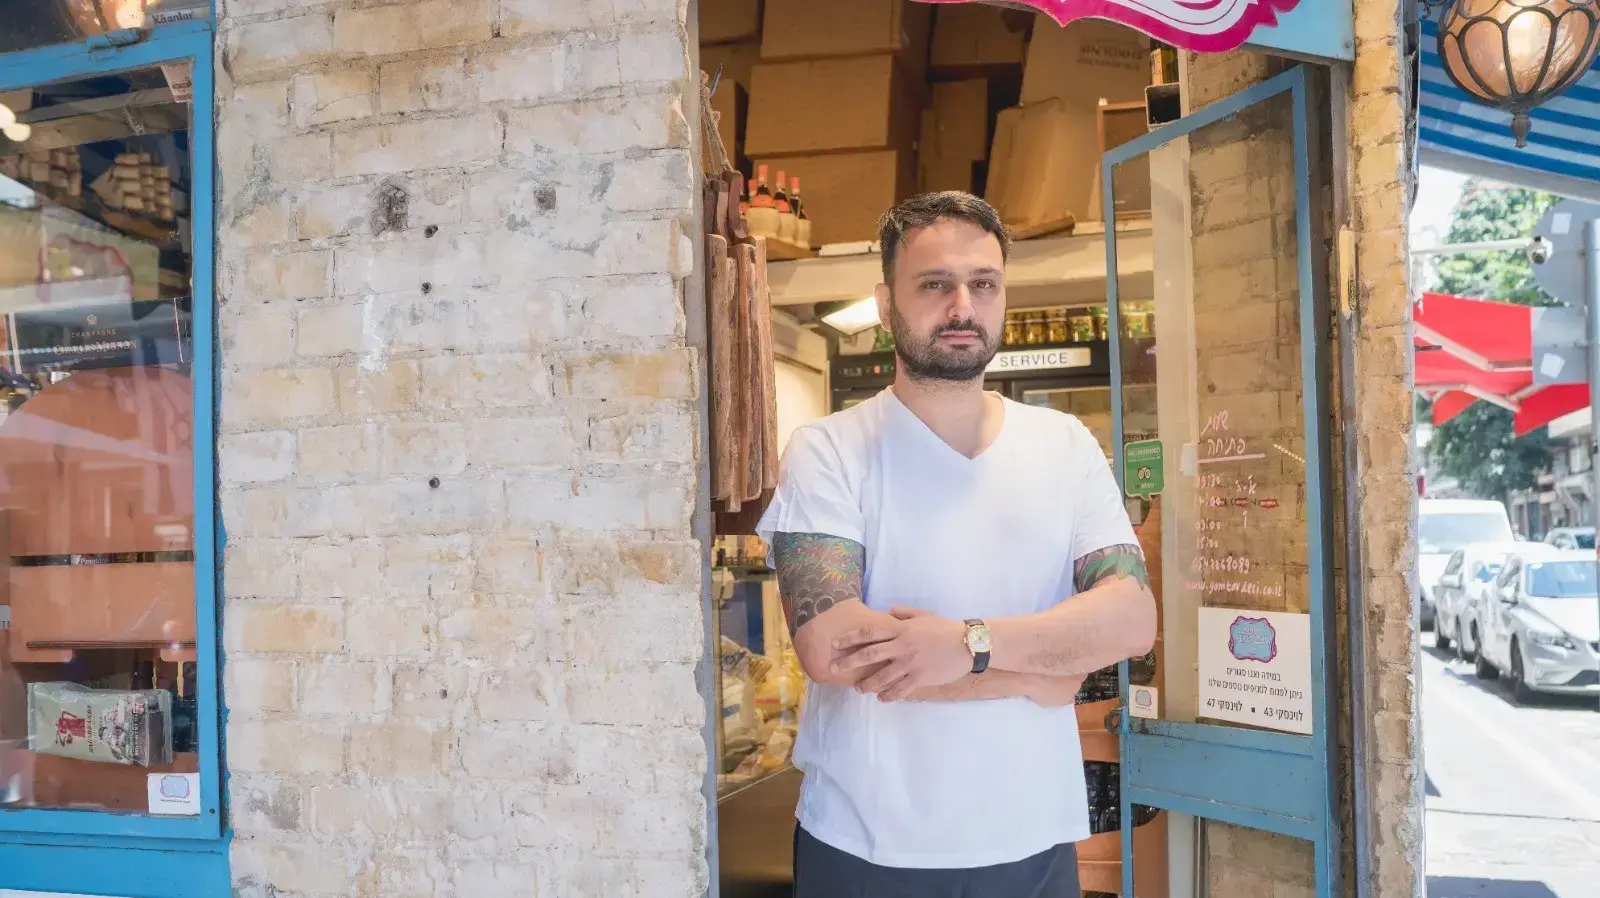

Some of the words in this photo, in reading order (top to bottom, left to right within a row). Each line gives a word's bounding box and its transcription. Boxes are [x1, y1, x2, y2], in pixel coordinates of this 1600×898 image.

[71, 328, 116, 338] CHAMPAGNE
[999, 352, 1068, 368] SERVICE
[1207, 437, 1246, 457] פתיחה
[1226, 667, 1247, 677] סגורים
[1247, 669, 1260, 679] ואנו
[1261, 673, 1281, 681] במידה
[1208, 677, 1221, 687] שלנו
[1243, 684, 1268, 694] לסניפים
[1269, 686, 1288, 697] לפנות
[1289, 690, 1303, 699] ניתן
[1206, 698, 1216, 707] 47
[1217, 700, 1243, 712] לוינסקי
[1263, 706, 1274, 717] 43
[1275, 709, 1304, 722] לוינסקי
